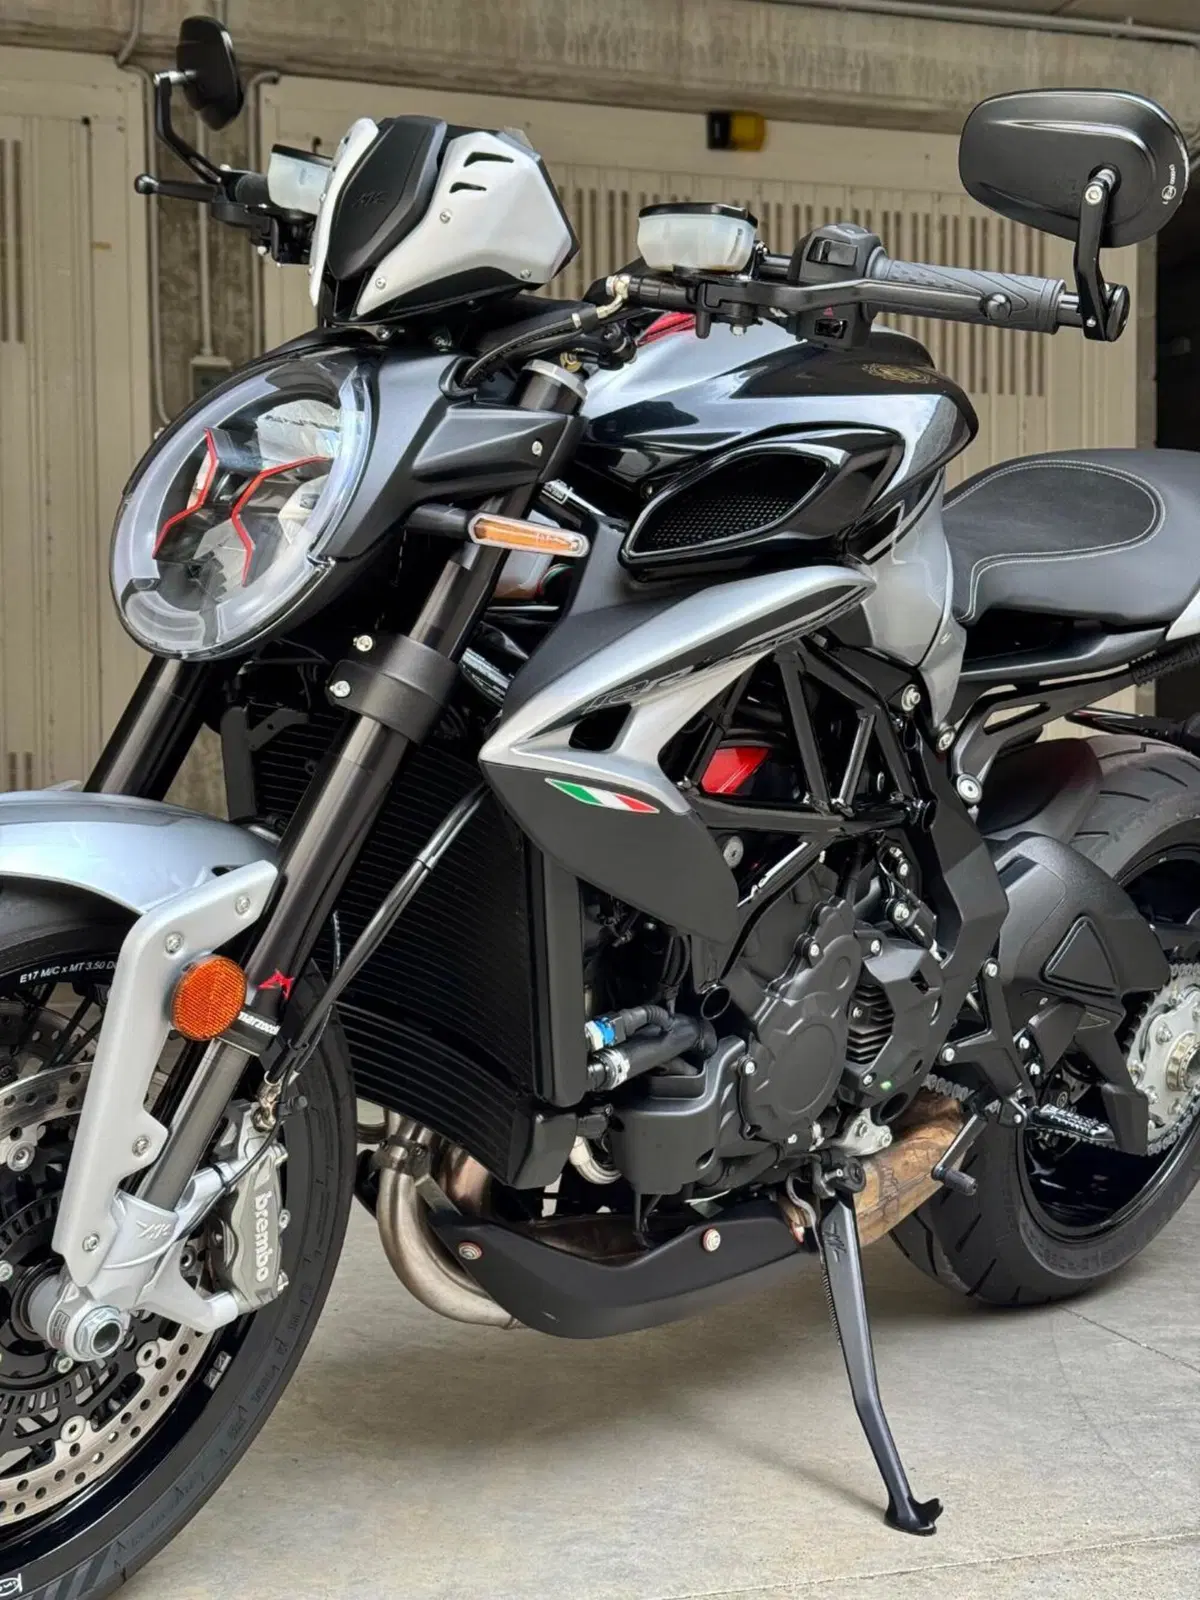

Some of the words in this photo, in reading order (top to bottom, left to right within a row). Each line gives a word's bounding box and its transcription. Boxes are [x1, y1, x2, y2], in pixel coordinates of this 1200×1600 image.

[20, 970, 39, 984] E17
[40, 966, 60, 978] M/C
[69, 962, 85, 973] MT
[255, 1191, 273, 1282] brembo
